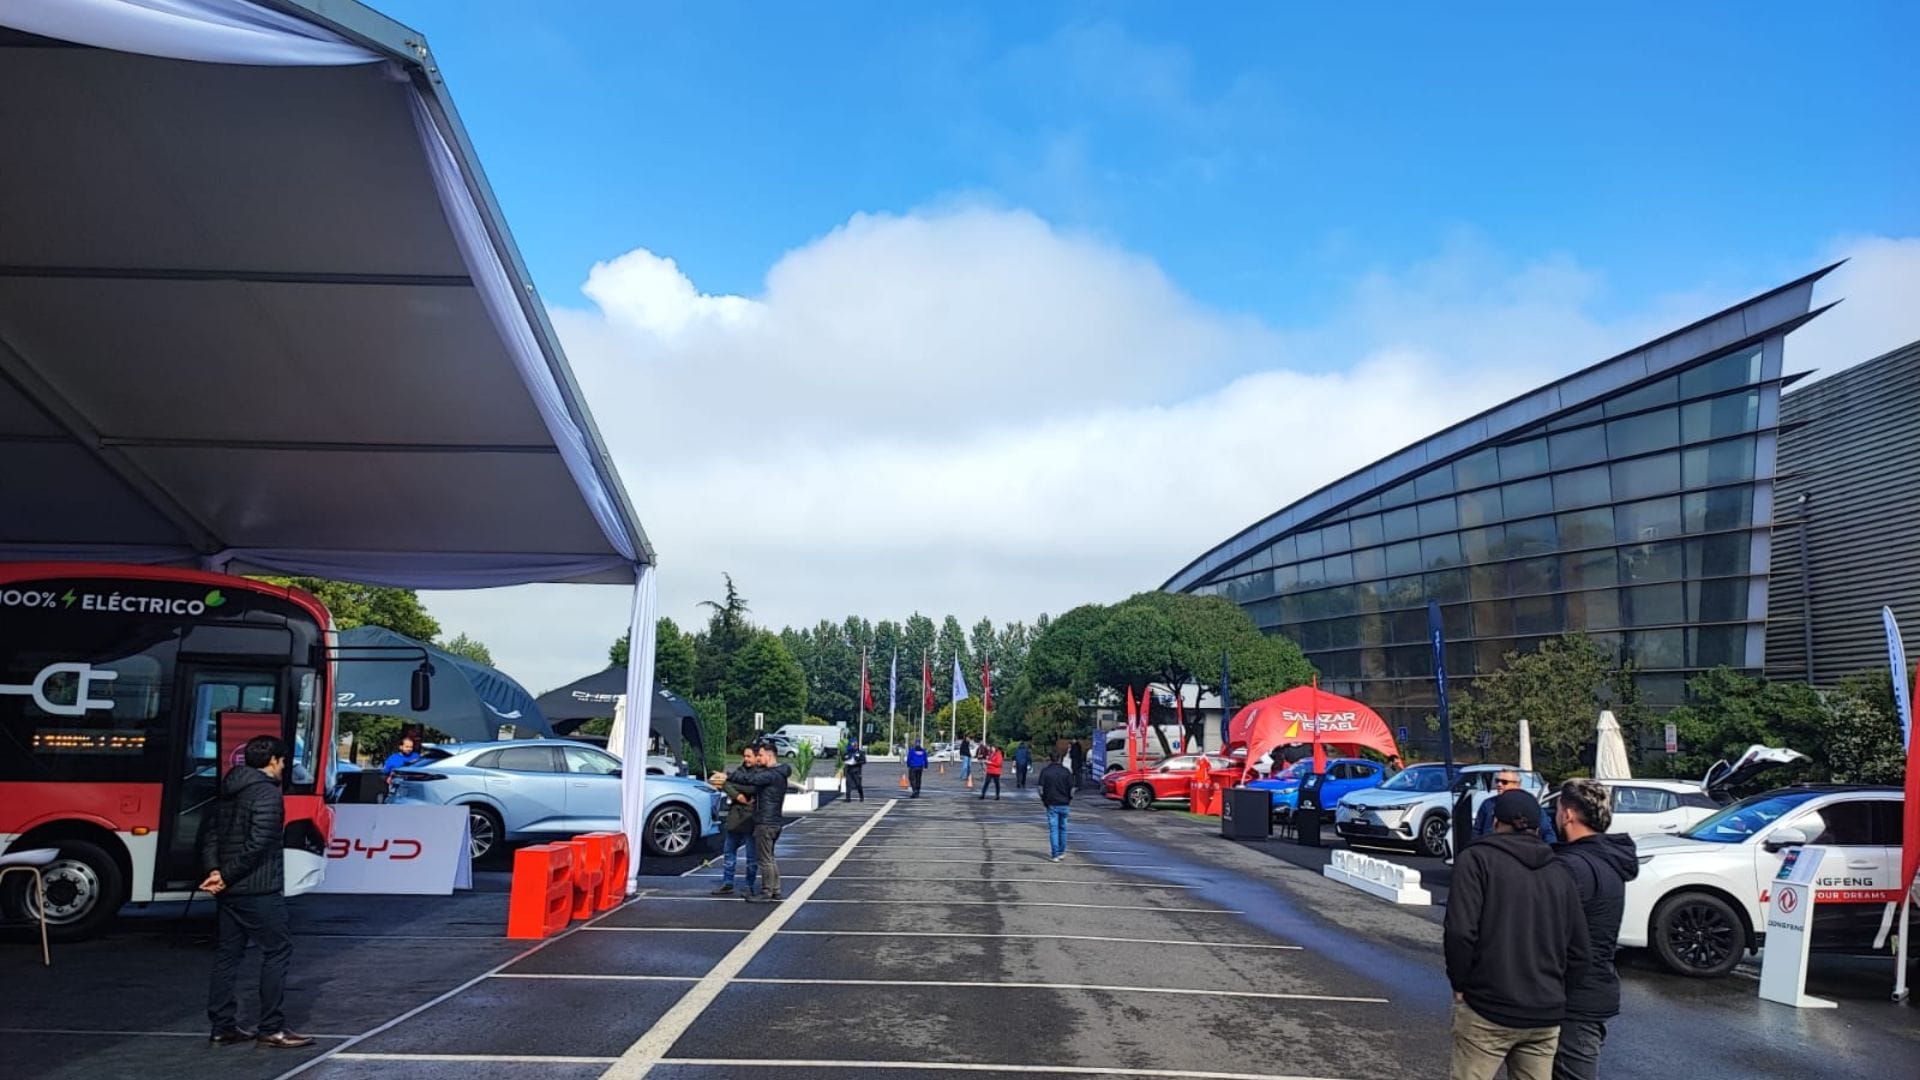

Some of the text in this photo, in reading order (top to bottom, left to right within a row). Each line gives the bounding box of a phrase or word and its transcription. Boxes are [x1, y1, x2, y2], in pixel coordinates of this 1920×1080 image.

[82, 592, 205, 615] ELÉCTRICO
[350, 699, 400, 707] AUTO
[326, 838, 422, 859] BYD
[1816, 877, 1873, 886] GFENG
[1816, 891, 1887, 899] OUR DREAMS
